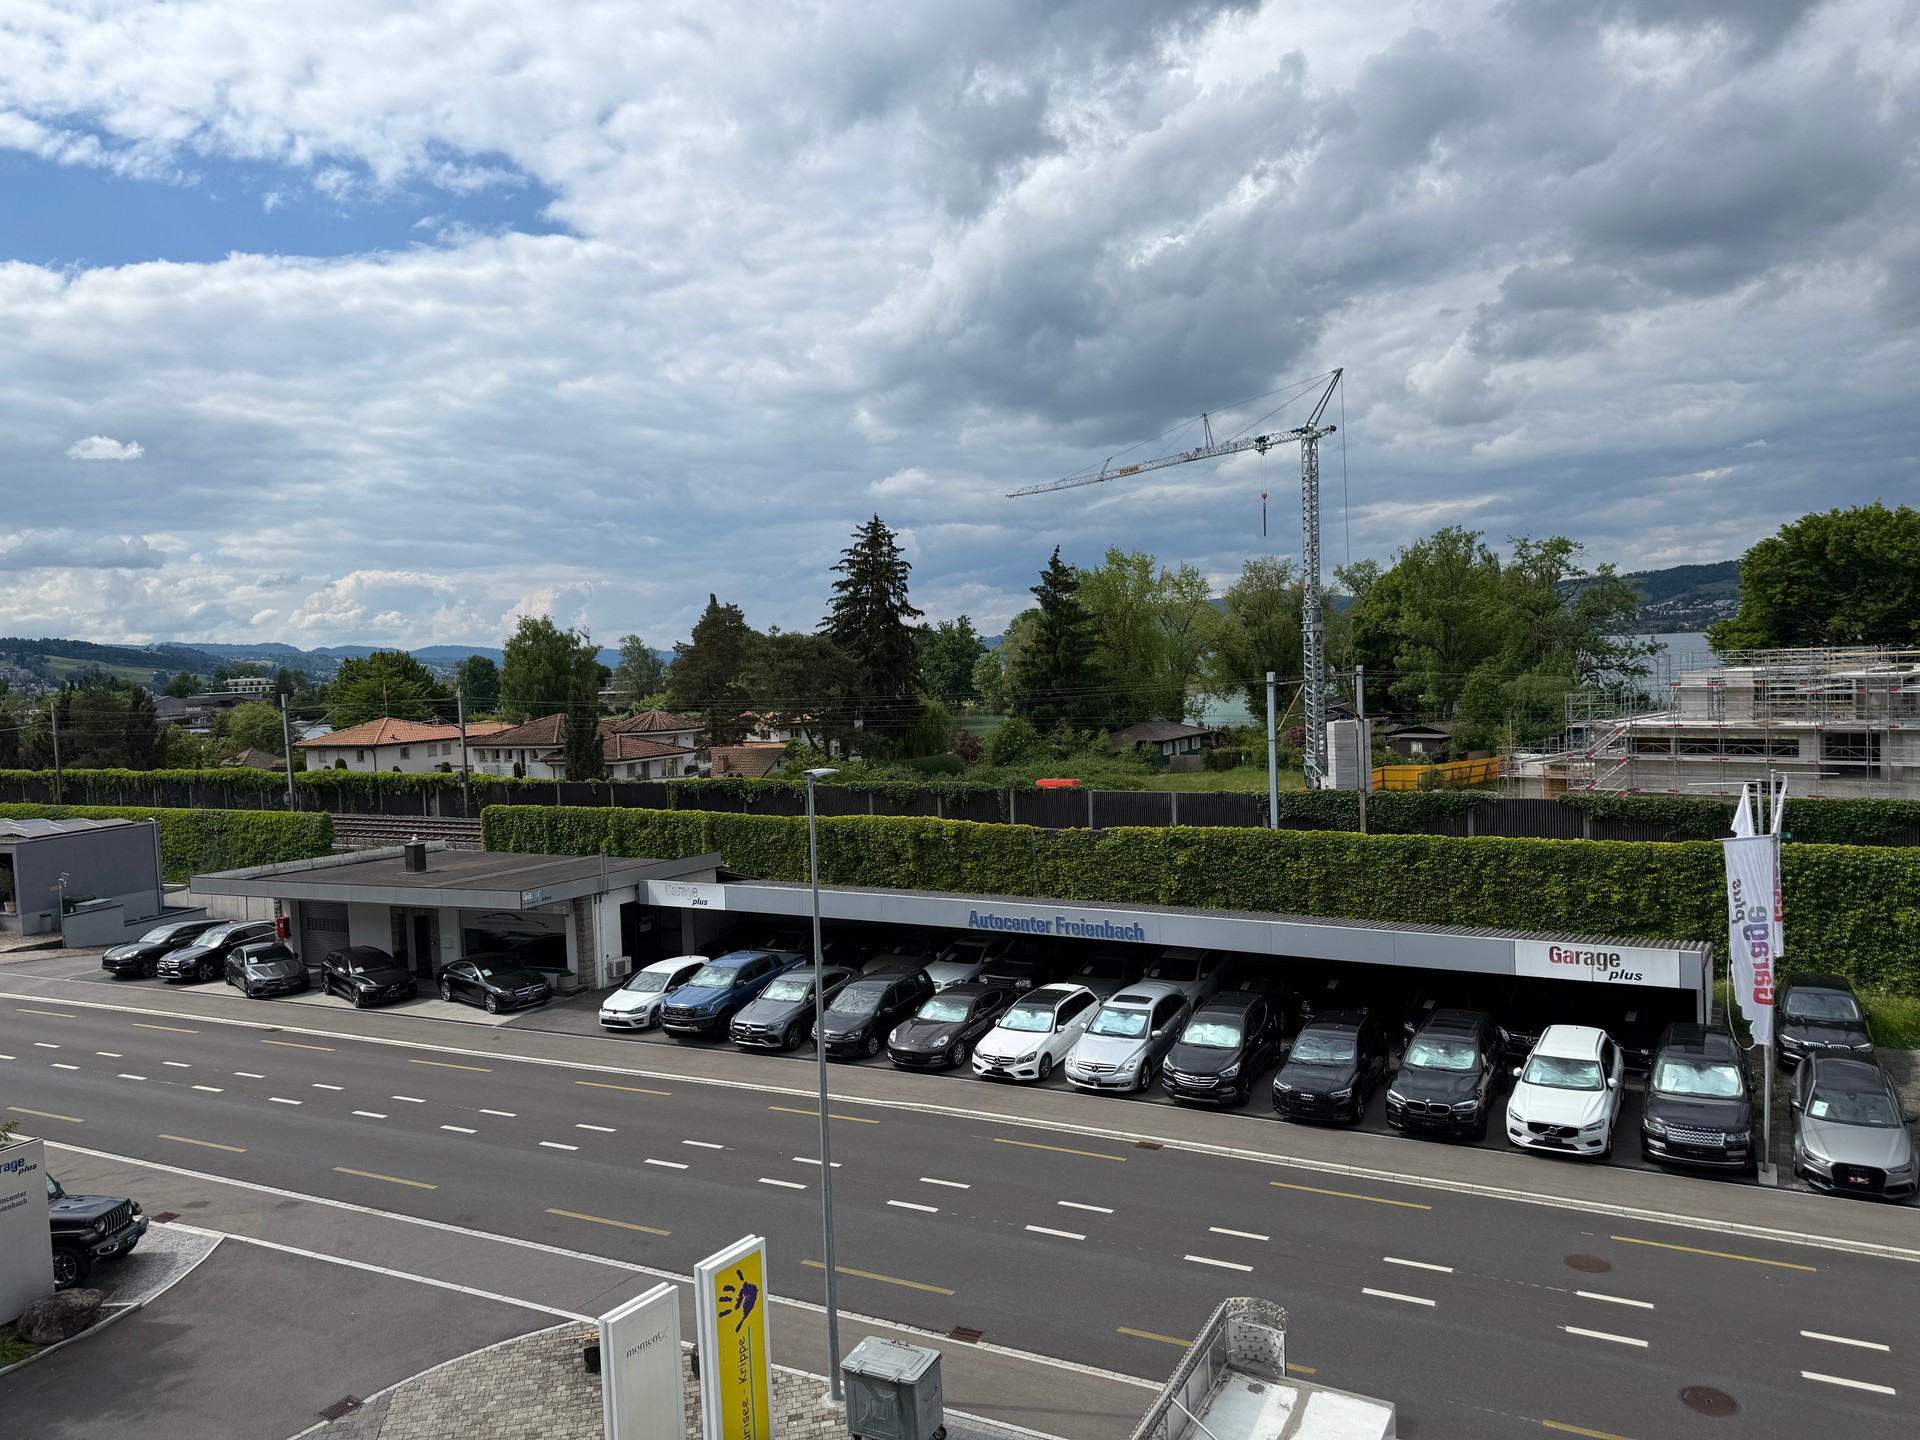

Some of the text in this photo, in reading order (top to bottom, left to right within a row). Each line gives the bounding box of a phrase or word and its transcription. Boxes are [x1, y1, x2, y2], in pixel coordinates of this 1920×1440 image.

[691, 898, 709, 906] plus
[968, 908, 1145, 942] Autocenter Freienbach
[1548, 945, 1621, 972] Garage
[1608, 969, 1644, 981] plus
[18, 1163, 37, 1176] plus
[738, 1336, 749, 1385] Krippe
